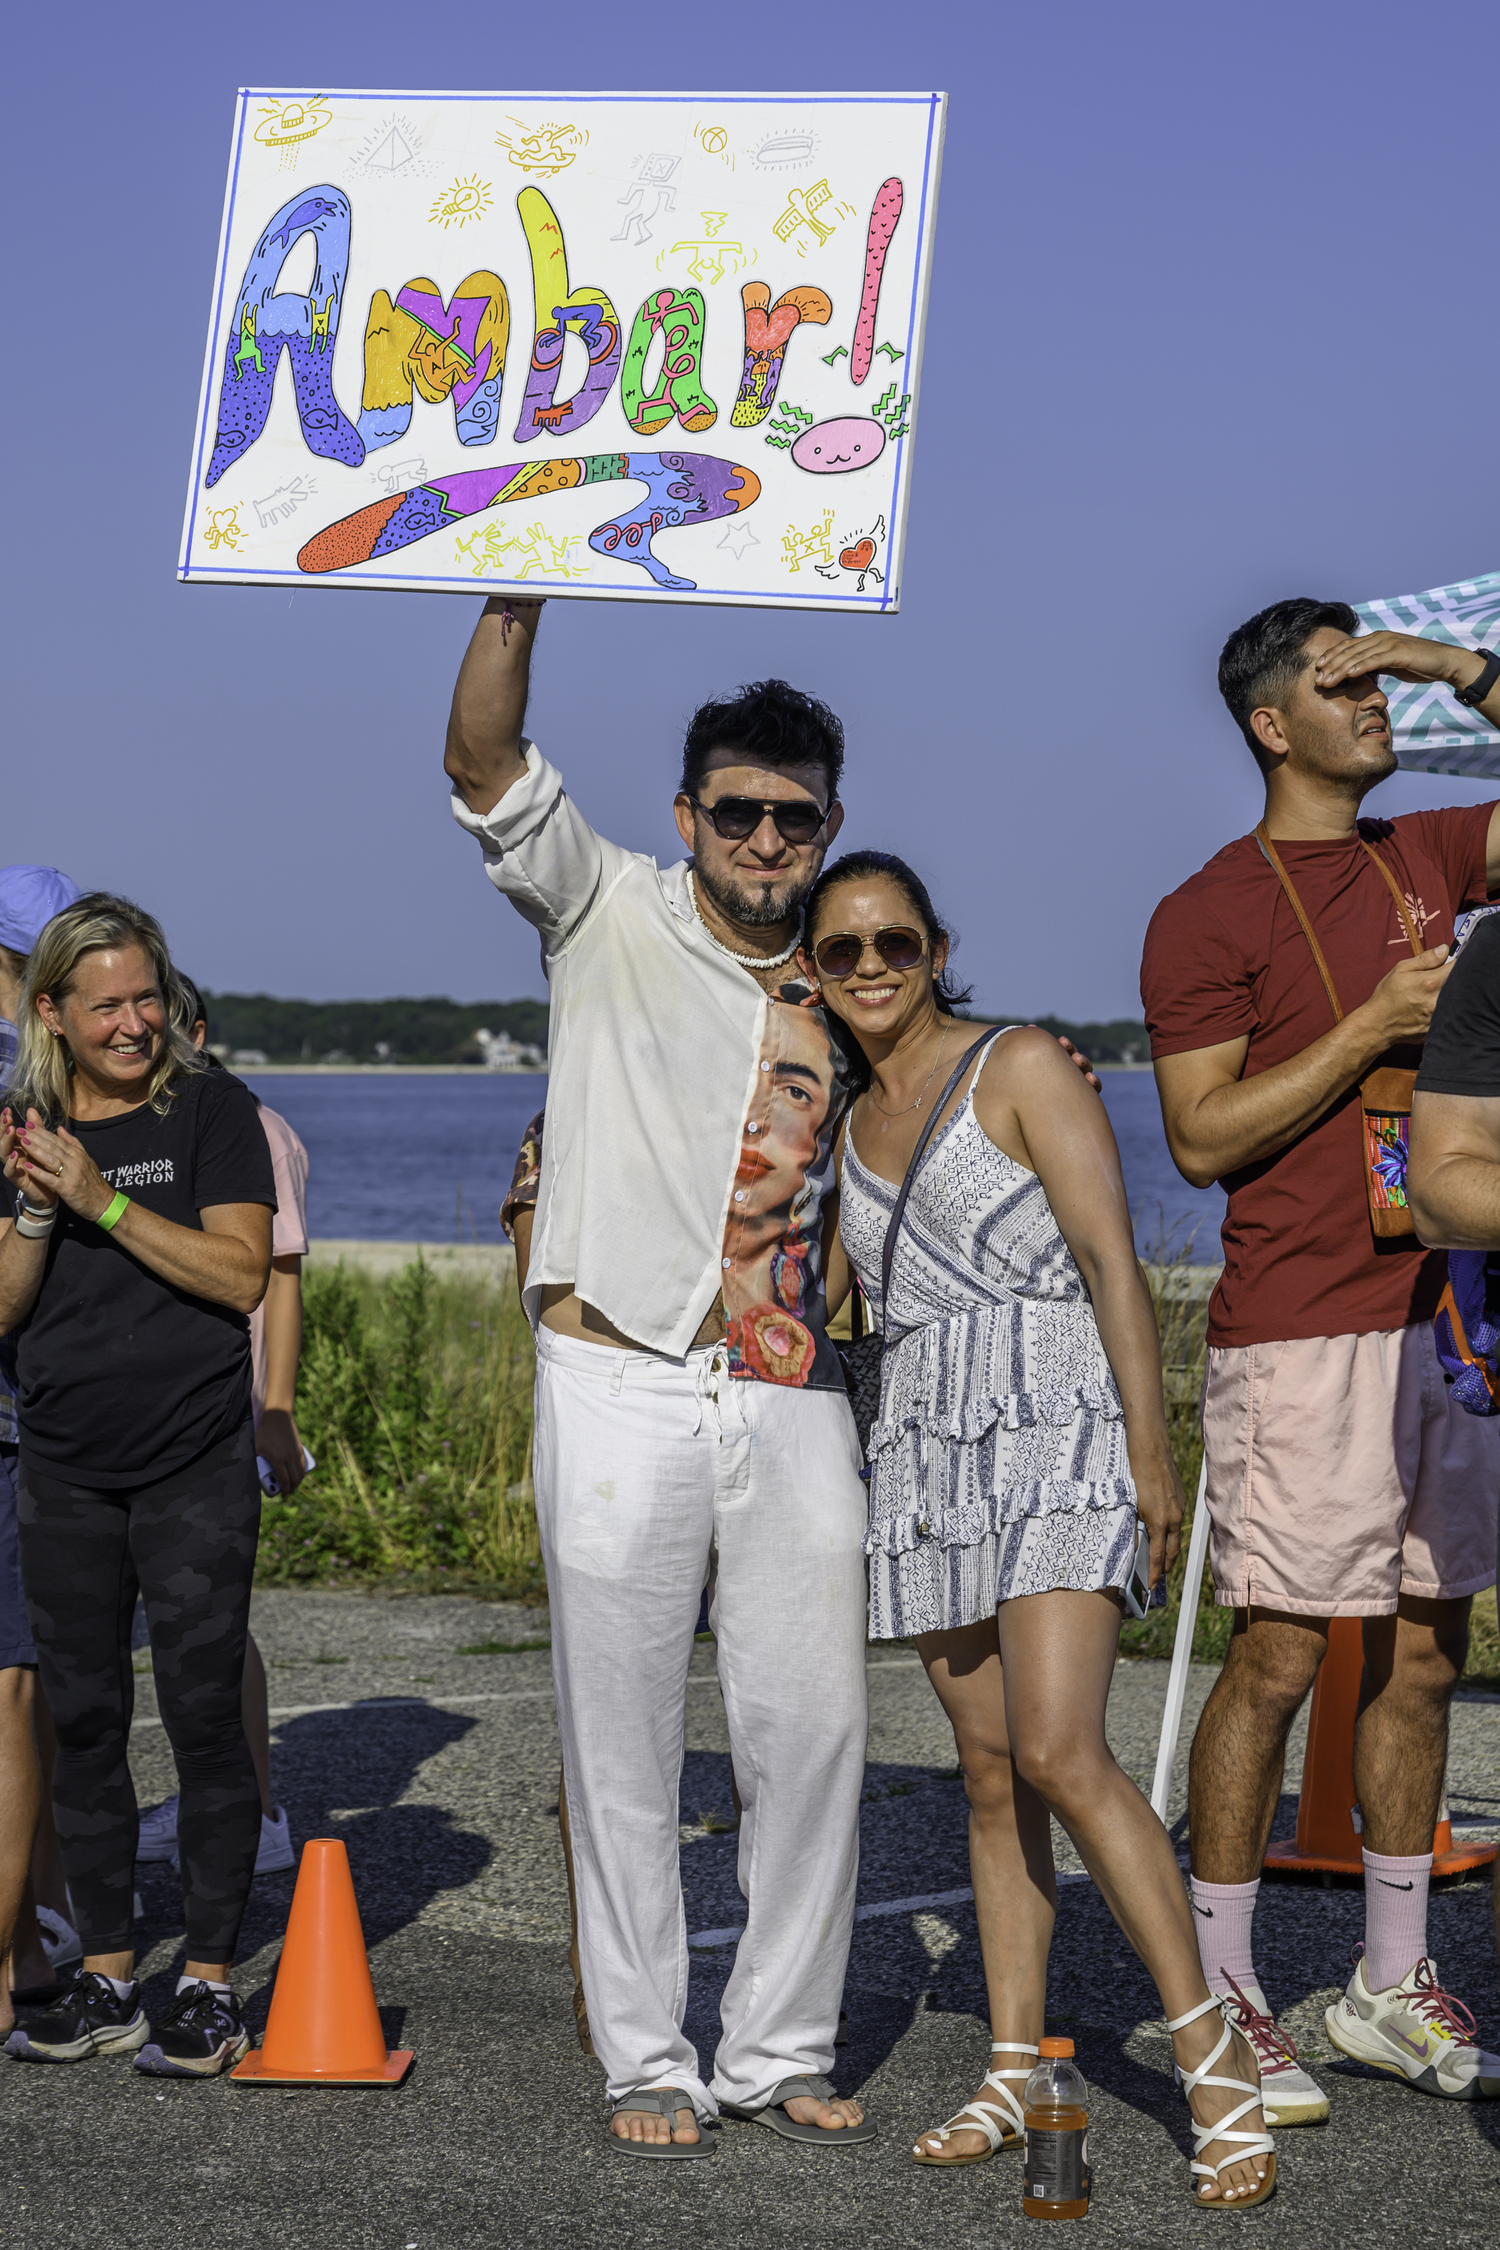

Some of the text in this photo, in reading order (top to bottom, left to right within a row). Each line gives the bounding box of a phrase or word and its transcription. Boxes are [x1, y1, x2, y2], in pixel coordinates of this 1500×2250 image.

[206, 177, 904, 488] Ambar!
[101, 1159, 174, 1181] IT WARRIOR
[115, 1172, 174, 1187] LEGION
